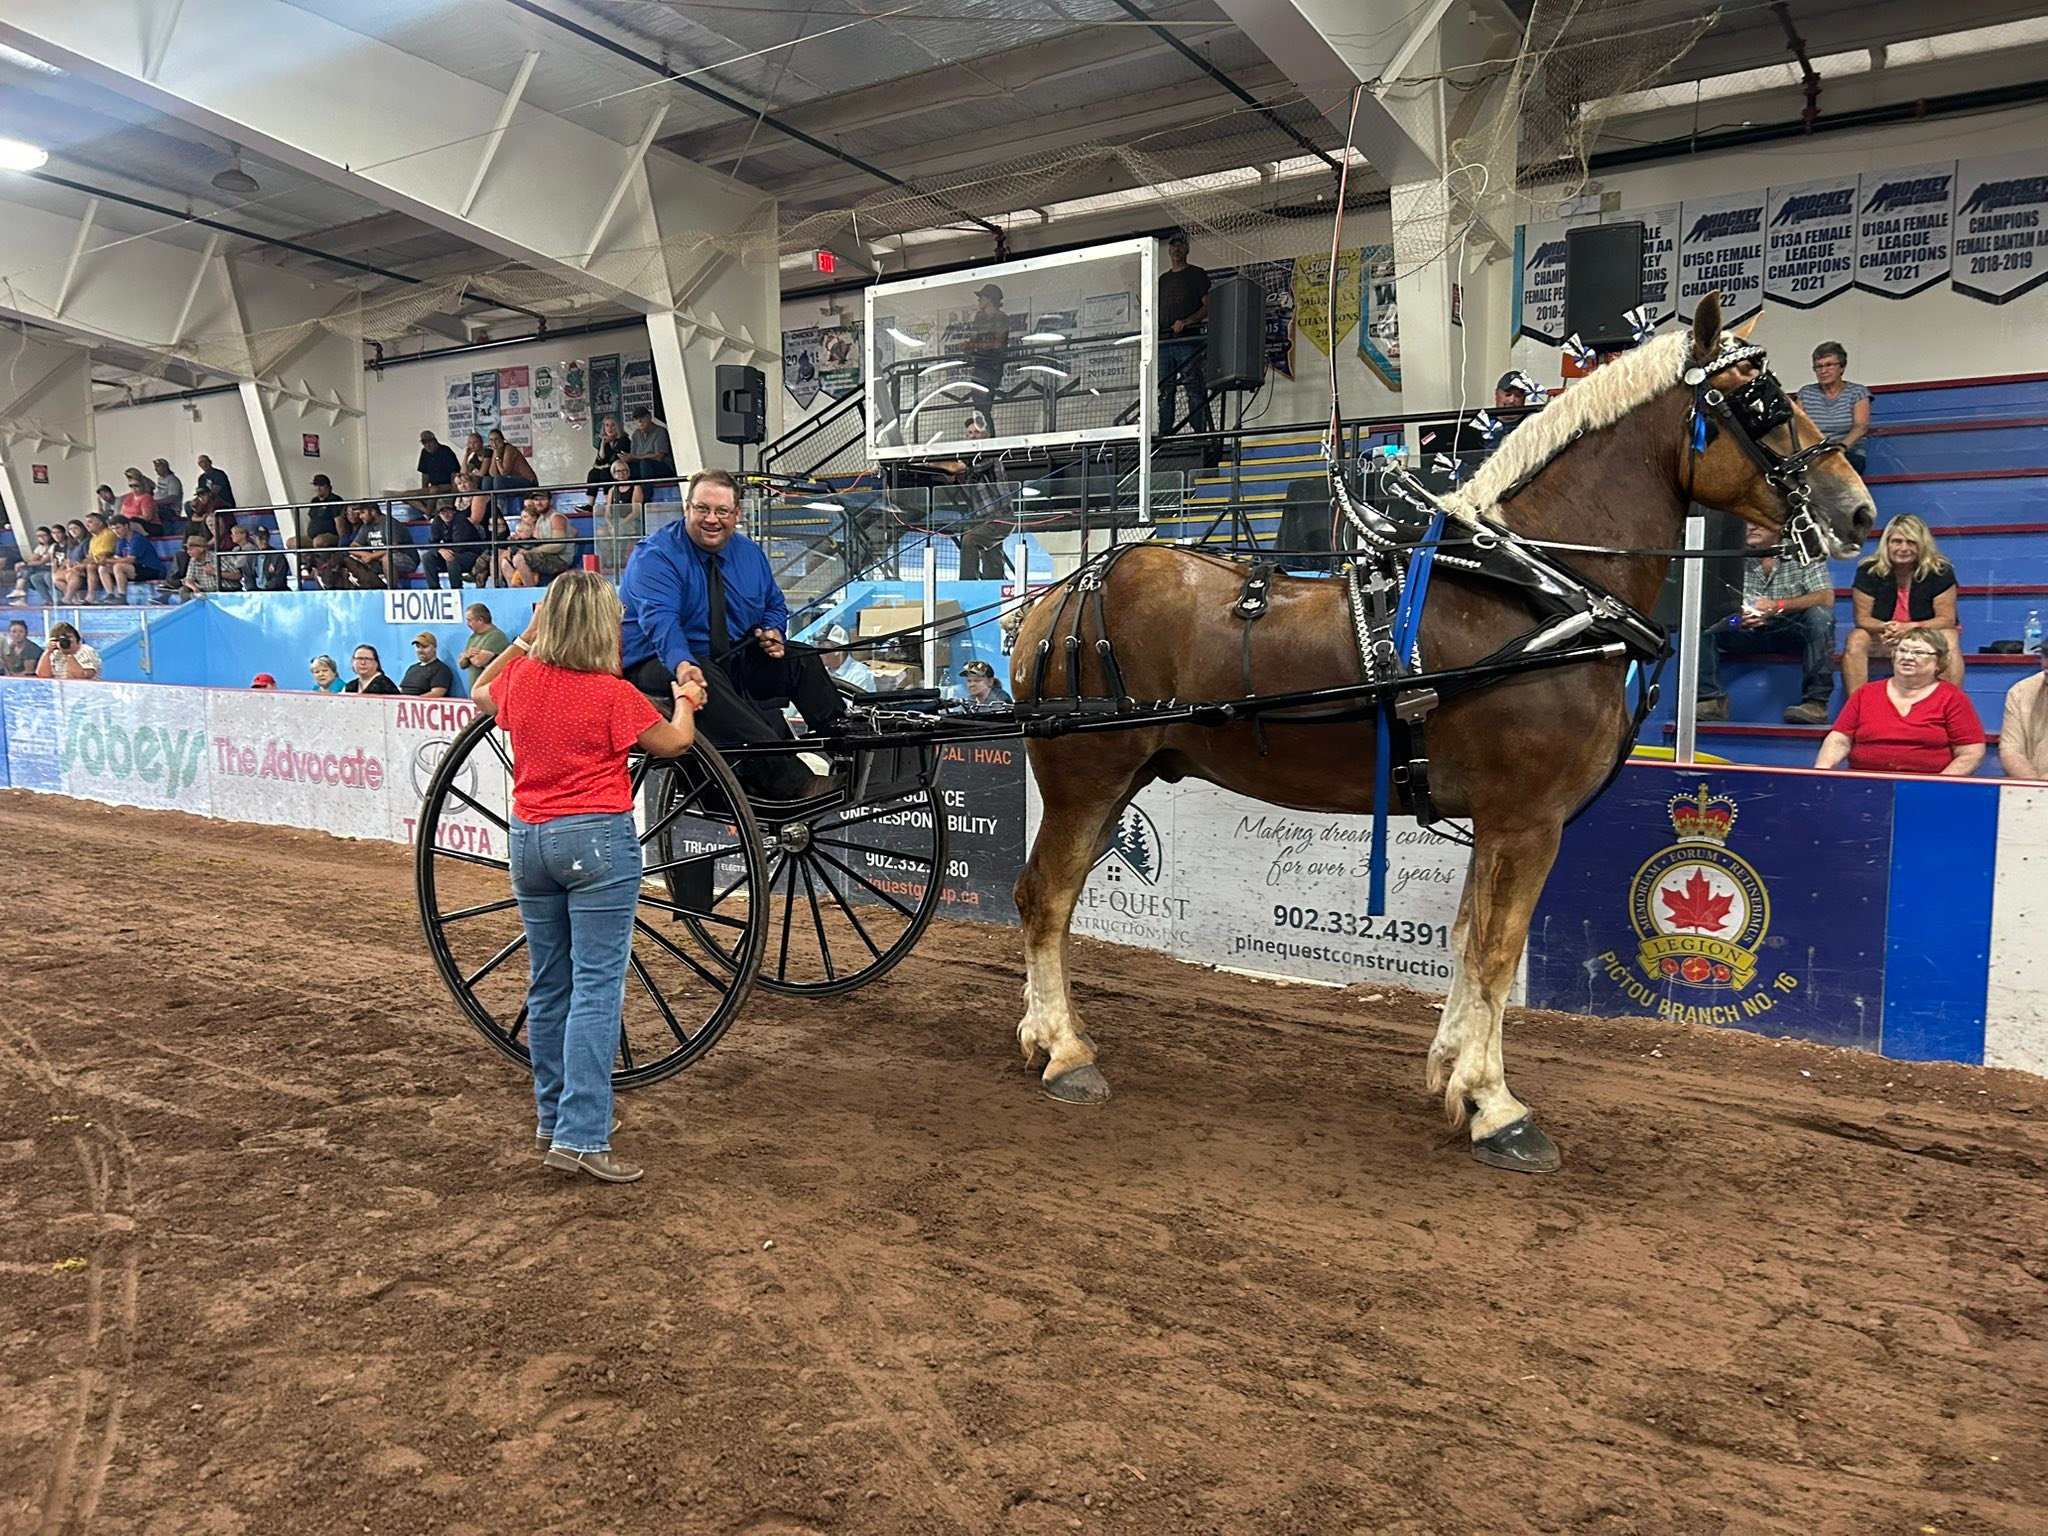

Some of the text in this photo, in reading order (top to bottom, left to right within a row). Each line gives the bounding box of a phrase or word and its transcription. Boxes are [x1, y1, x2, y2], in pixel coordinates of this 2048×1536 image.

[1862, 213, 1948, 237] U18AA FEMALE
[1969, 210, 2039, 234] CHAMPIONS
[1771, 225, 1852, 249] U13A FEMALE
[1877, 231, 1930, 251] LEAGUE
[1956, 239, 1991, 256] FEMALE
[1993, 231, 2035, 252] BANTAM
[1683, 244, 1762, 268] U15C FEMALE
[1785, 243, 1835, 262] LEAGUE
[1859, 245, 1947, 269] CHAMPIONS
[1970, 251, 2032, 275] 2018-2019
[1534, 269, 1566, 287] CHAMP
[1698, 262, 1745, 281] LEAGUE
[1768, 257, 1851, 280] CHAMPIONS
[1884, 264, 1920, 282] 2021
[1682, 275, 1760, 298] CHAMPIONS
[1791, 275, 1825, 292] 2021
[1525, 287, 1552, 305] FEMALE
[1536, 304, 1566, 321] 2010-2
[391, 592, 454, 621] HOME
[396, 702, 484, 731] ANCHO
[213, 736, 384, 790] The Advocate
[974, 748, 1012, 765] HVAC
[403, 818, 492, 857] TYOTA
[1234, 815, 1316, 853] Making
[1320, 821, 1390, 845] dream
[1266, 845, 1303, 887] for
[1307, 860, 1346, 876] over
[1391, 866, 1457, 894] years
[1640, 848, 1764, 943] MEMORIAM EORUM RETINEBIMUS
[1273, 904, 1449, 949] 902.332.4391
[1652, 940, 1743, 964] LEGION
[1598, 950, 1799, 1026] PICTOU BRANCH NO. 16
